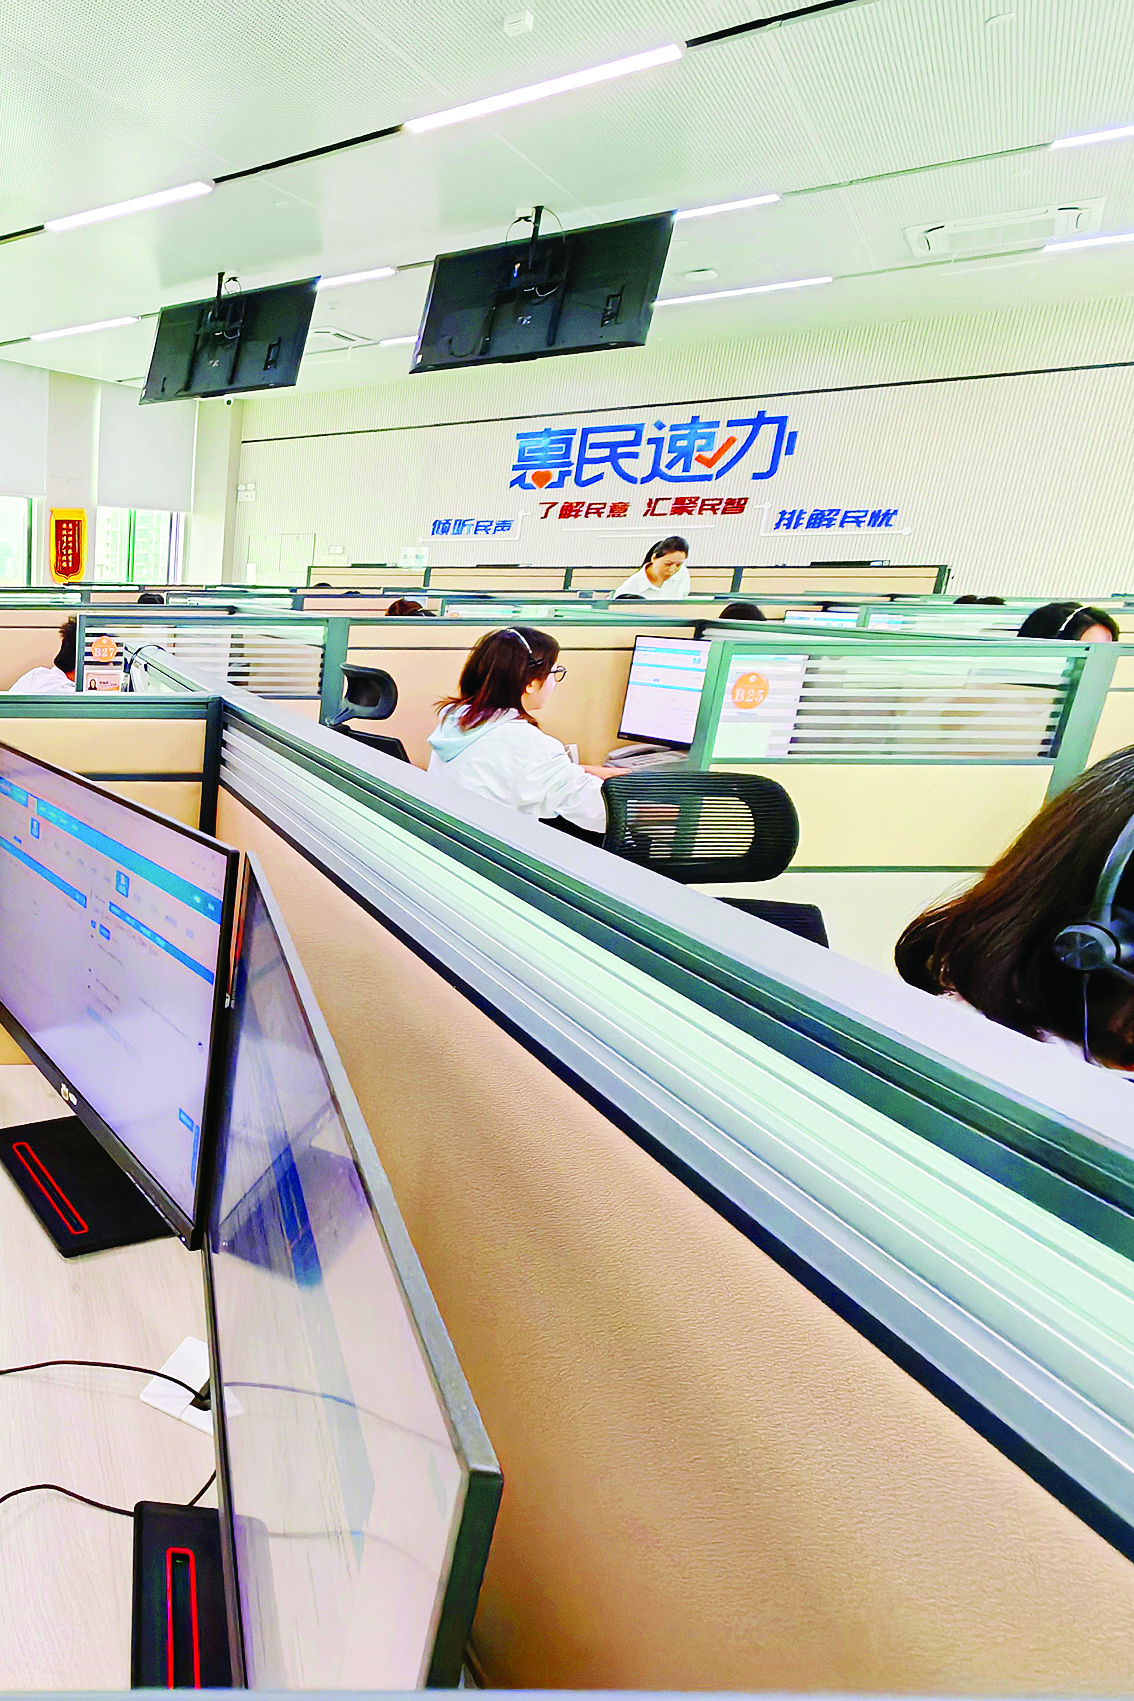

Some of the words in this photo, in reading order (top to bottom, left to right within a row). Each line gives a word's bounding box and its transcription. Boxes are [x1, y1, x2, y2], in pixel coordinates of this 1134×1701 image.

[509, 410, 799, 490] 惠民速办
[538, 501, 631, 520] 了解民意
[643, 496, 749, 518] 汇聚民智
[431, 518, 515, 536] 倾听民声
[773, 508, 899, 531] 排解民忧
[93, 647, 115, 658] B27
[734, 688, 765, 703] B25
